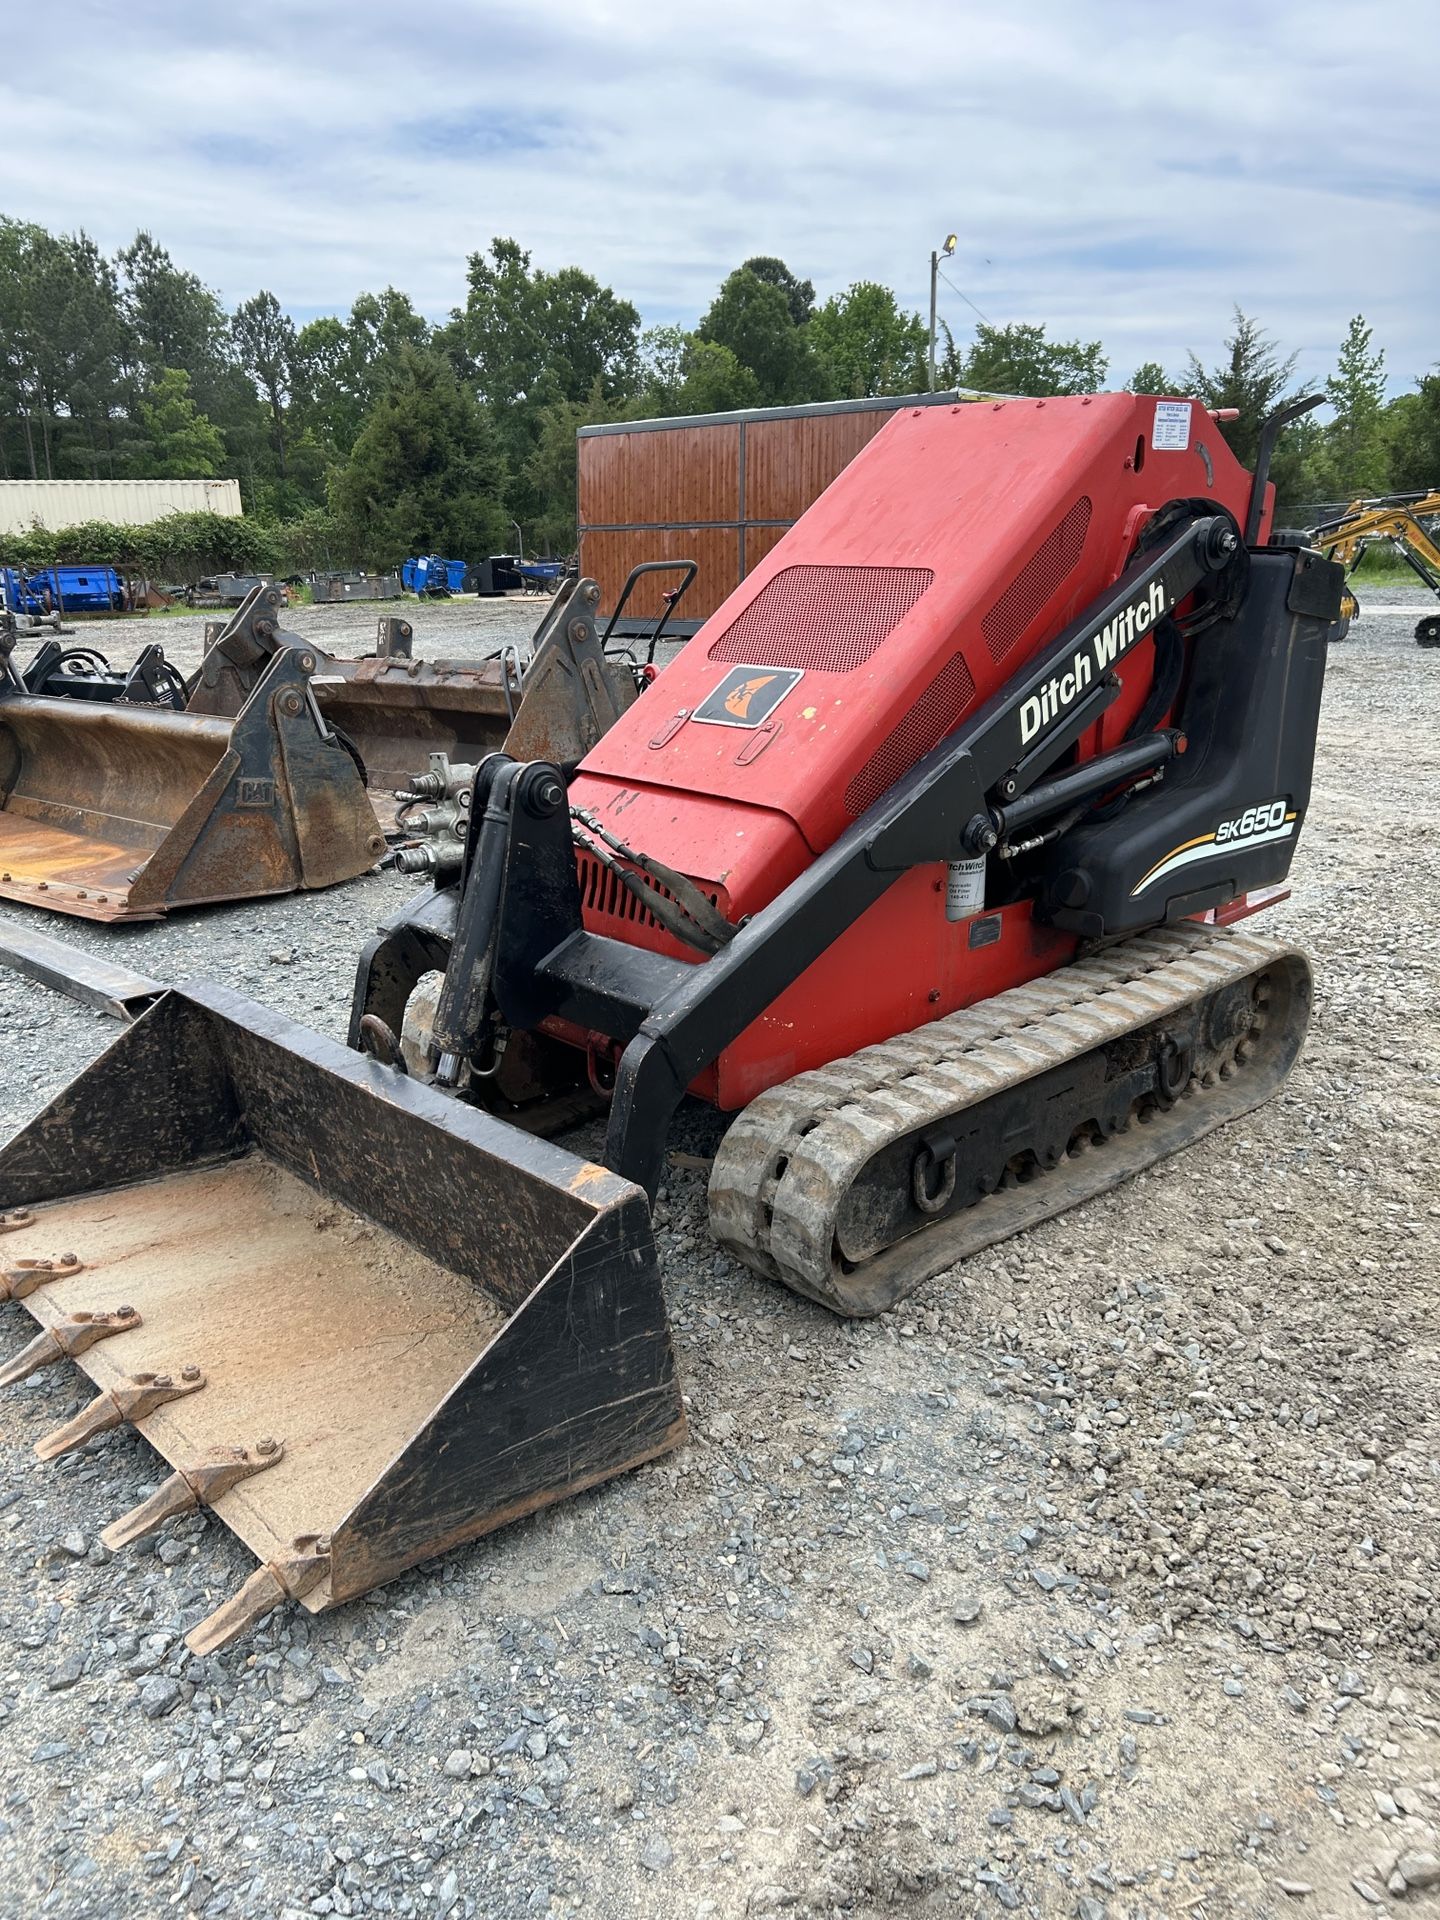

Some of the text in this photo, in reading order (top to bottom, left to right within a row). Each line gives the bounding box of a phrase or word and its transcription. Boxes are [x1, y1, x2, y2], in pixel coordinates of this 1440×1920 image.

[1020, 582, 1165, 745] Ditch Witch
[242, 781, 273, 803] CAT
[1216, 801, 1287, 842] SK650
